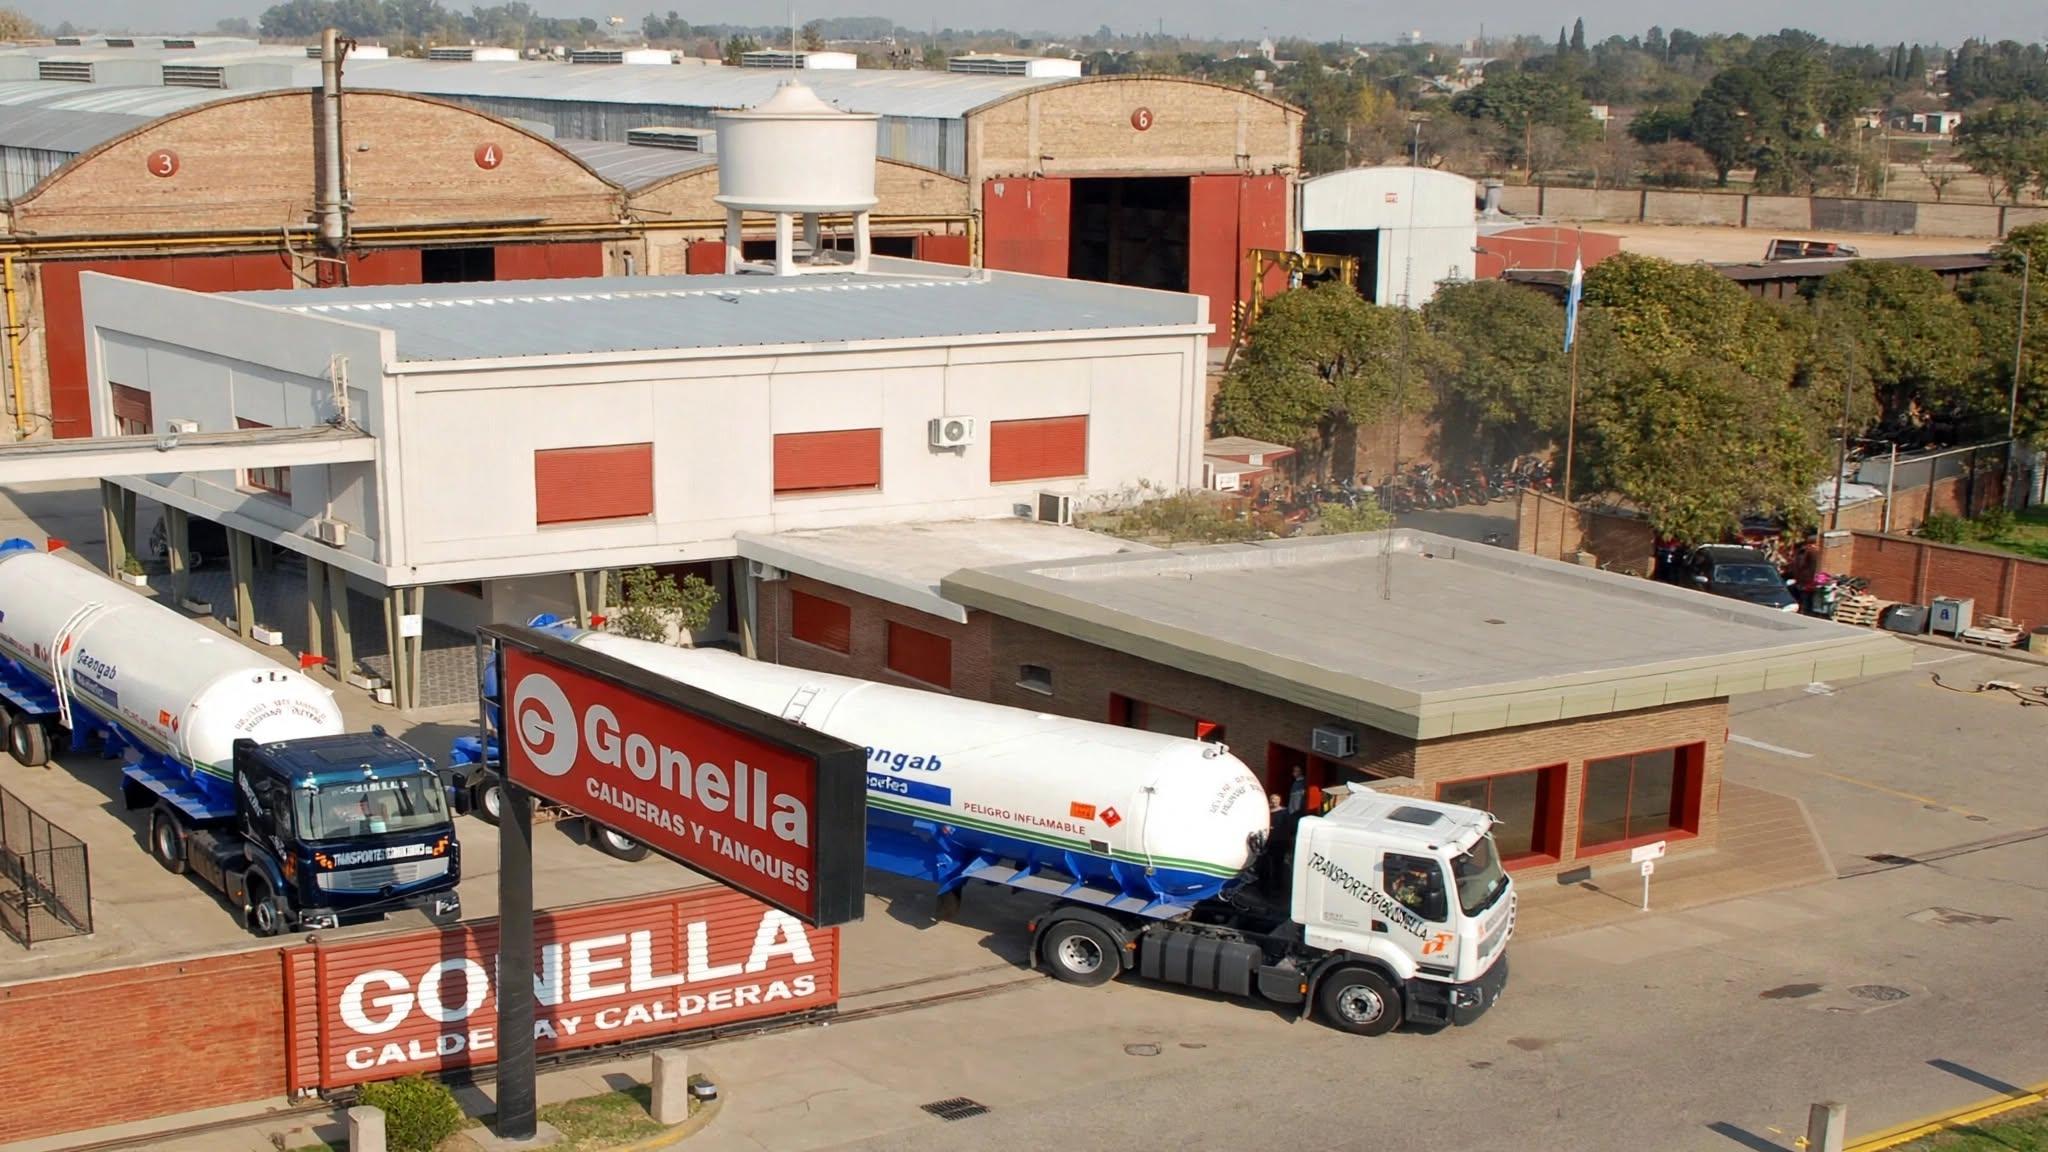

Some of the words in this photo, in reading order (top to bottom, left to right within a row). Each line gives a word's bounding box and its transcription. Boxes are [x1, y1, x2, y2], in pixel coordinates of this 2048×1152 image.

[1140, 110, 1148, 128] 6
[158, 154, 172, 175] 3
[483, 146, 497, 166] 4
[584, 704, 809, 848] Gonella
[586, 777, 686, 837] CALDERAS
[690, 822, 705, 846] Y
[709, 830, 810, 893] TANQUES
[963, 802, 1011, 820] PELIGRO
[1014, 812, 1087, 836] INFLAMABLE
[560, 1016, 583, 1036] Y
[594, 975, 817, 1030] CALDERAS
